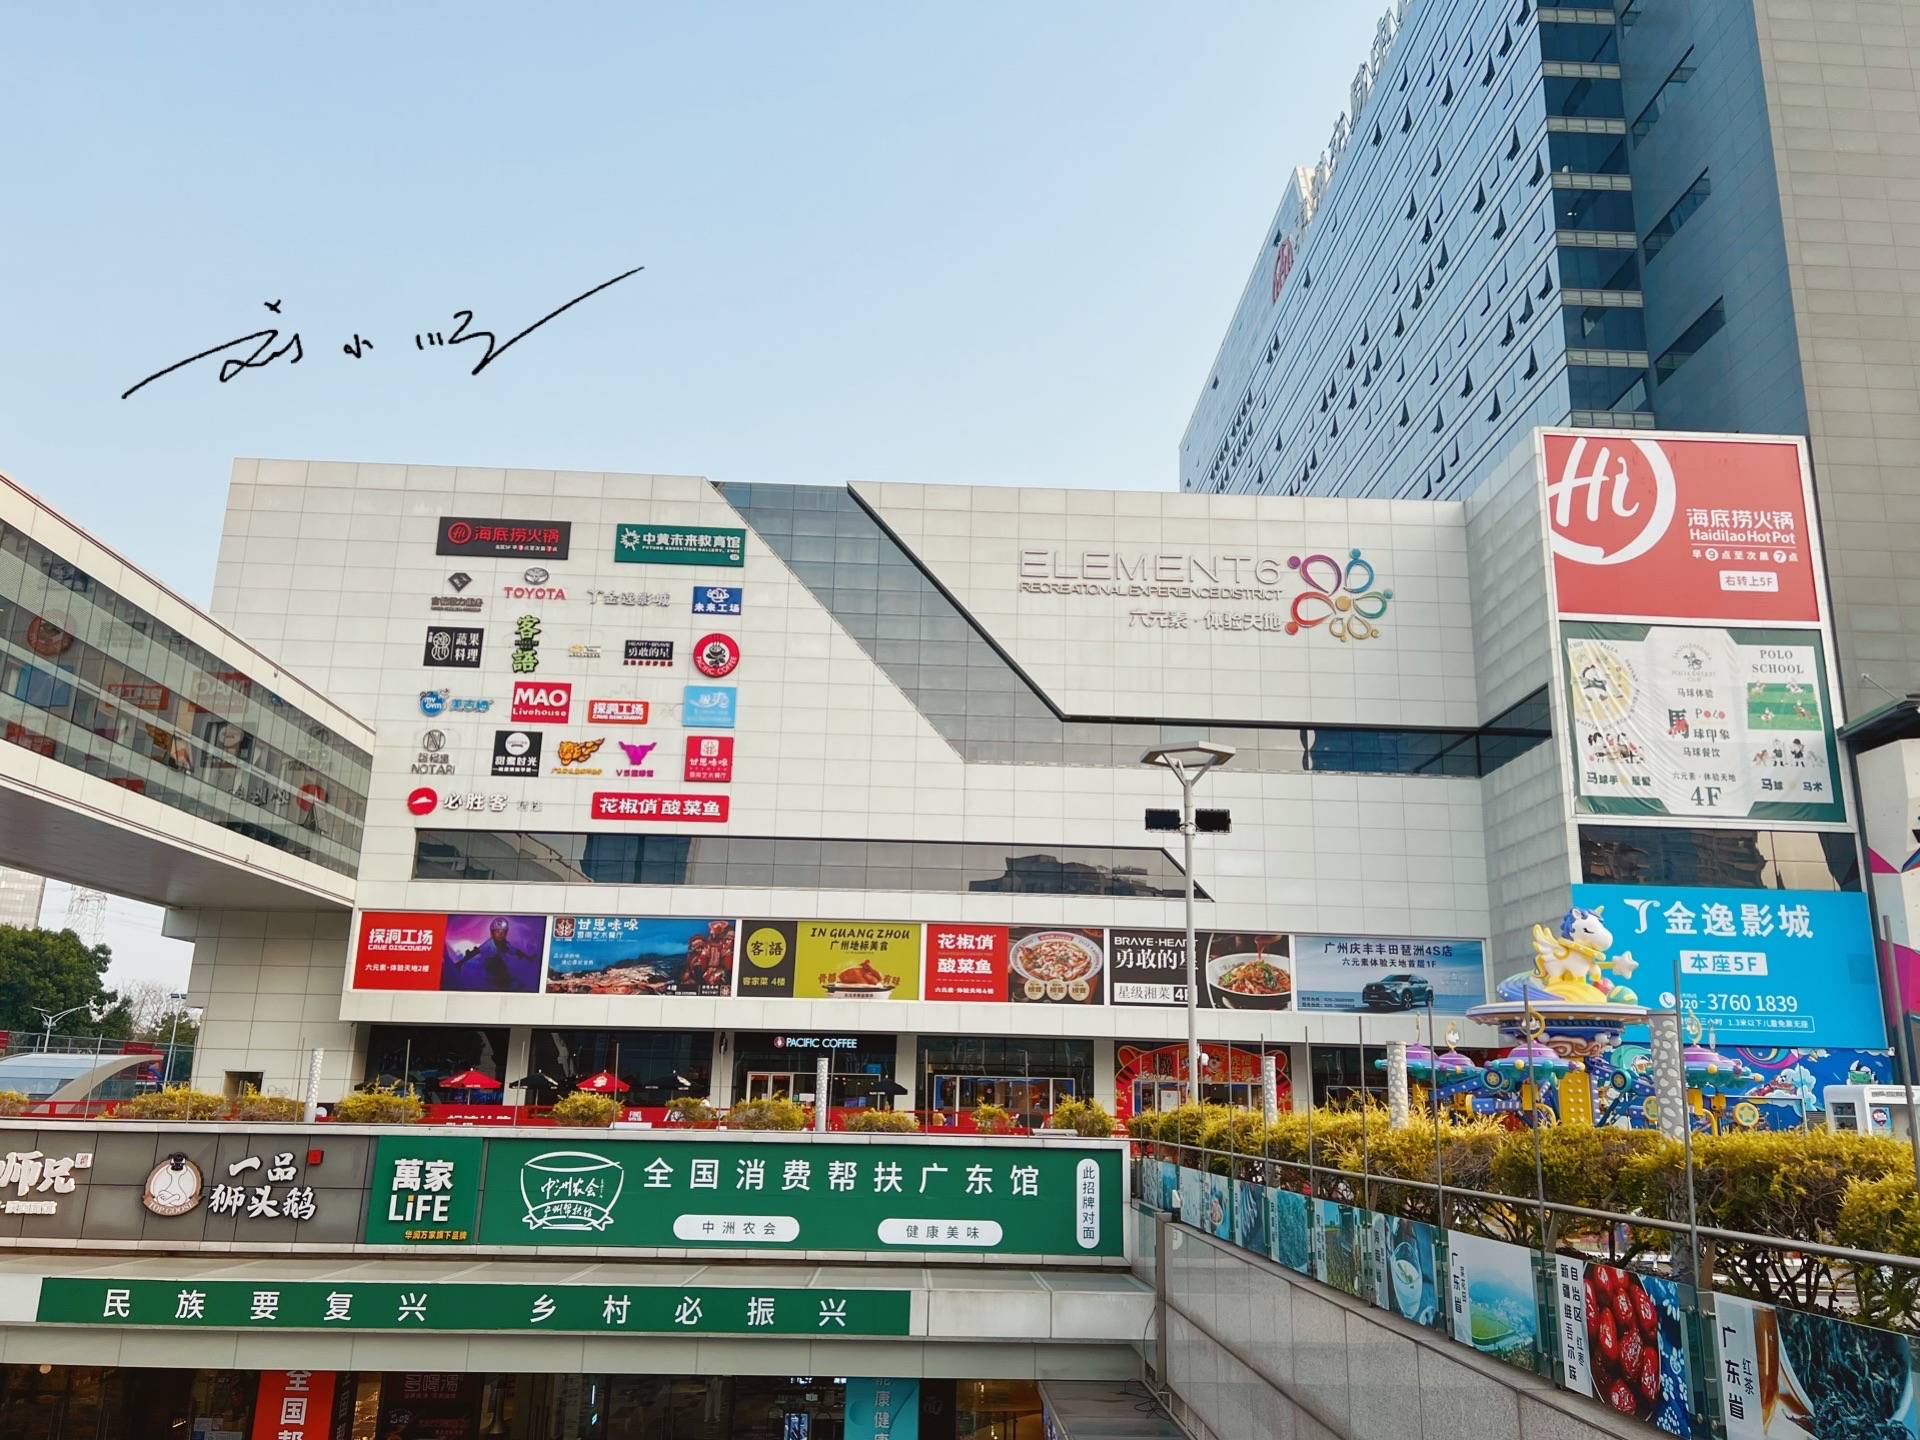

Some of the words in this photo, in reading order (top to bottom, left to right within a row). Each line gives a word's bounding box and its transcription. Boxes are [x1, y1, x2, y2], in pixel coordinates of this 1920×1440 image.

[1686, 508, 1796, 530] 海底捞火锅
[474, 525, 561, 545] 海底捞火锅
[642, 532, 741, 549] 中黄未来教育馆
[1690, 529, 1746, 543] Haidilao
[1748, 531, 1771, 544] Hot
[1773, 532, 1796, 546] Pot
[1724, 574, 1774, 588] 右转上5F
[504, 586, 567, 601] TOYOTA
[1020, 582, 1129, 598] RECREATIONAL
[1129, 586, 1220, 600] EXPERIENCE
[1220, 588, 1283, 602] DISTRICT
[454, 648, 479, 662] 料理
[1760, 649, 1793, 660] POLO
[1751, 663, 1805, 675] SCHOOL
[513, 688, 569, 707] MAO
[1677, 687, 1714, 699] 马球体验
[512, 707, 568, 717] Livehouse
[1682, 745, 1722, 758] 马球餐饮
[494, 755, 538, 767] 甜蜜时光
[444, 791, 508, 813] 必胜客
[1690, 786, 1722, 807] 4F
[600, 797, 661, 813] 花椒俏
[661, 800, 721, 817] 酸菜鱼
[1663, 901, 1814, 939] 金逸影城
[368, 928, 433, 945] 探洞工场
[810, 928, 826, 938] IN
[829, 929, 874, 940] GUANG
[877, 930, 911, 940] ZHOU
[937, 933, 995, 950] 花椒俏
[389, 944, 432, 952] DISCOVERY
[829, 939, 890, 953] 广州地标美食
[937, 958, 994, 975] 酸菜鱼
[1690, 953, 1758, 974] 本座5F
[1341, 966, 1437, 979] 六元素体验天地首层1F
[741, 976, 770, 987] 客家菜
[1118, 983, 1171, 1000] 星级湘菜
[1755, 995, 1798, 1012] 1839
[786, 1038, 820, 1049] PACIFIC
[822, 1038, 857, 1049] COFFEE
[230, 1152, 298, 1184] 一品
[392, 1159, 455, 1193] 萬家
[642, 1157, 1041, 1197] 全国消费帮扶广东馆
[207, 1184, 318, 1222] 狮头鹅
[1082, 1165, 1097, 1241] 此招牌对面
[404, 1230, 468, 1241] 华润万家旗下品牌
[702, 1221, 777, 1237] 中洲农会
[905, 1224, 981, 1241] 健康美味
[102, 1288, 427, 1323] 民族要复兴
[529, 1293, 849, 1328] 乡村必振兴
[1721, 1325, 1745, 1420] 广东省
[1741, 1357, 1755, 1396] 红茶
